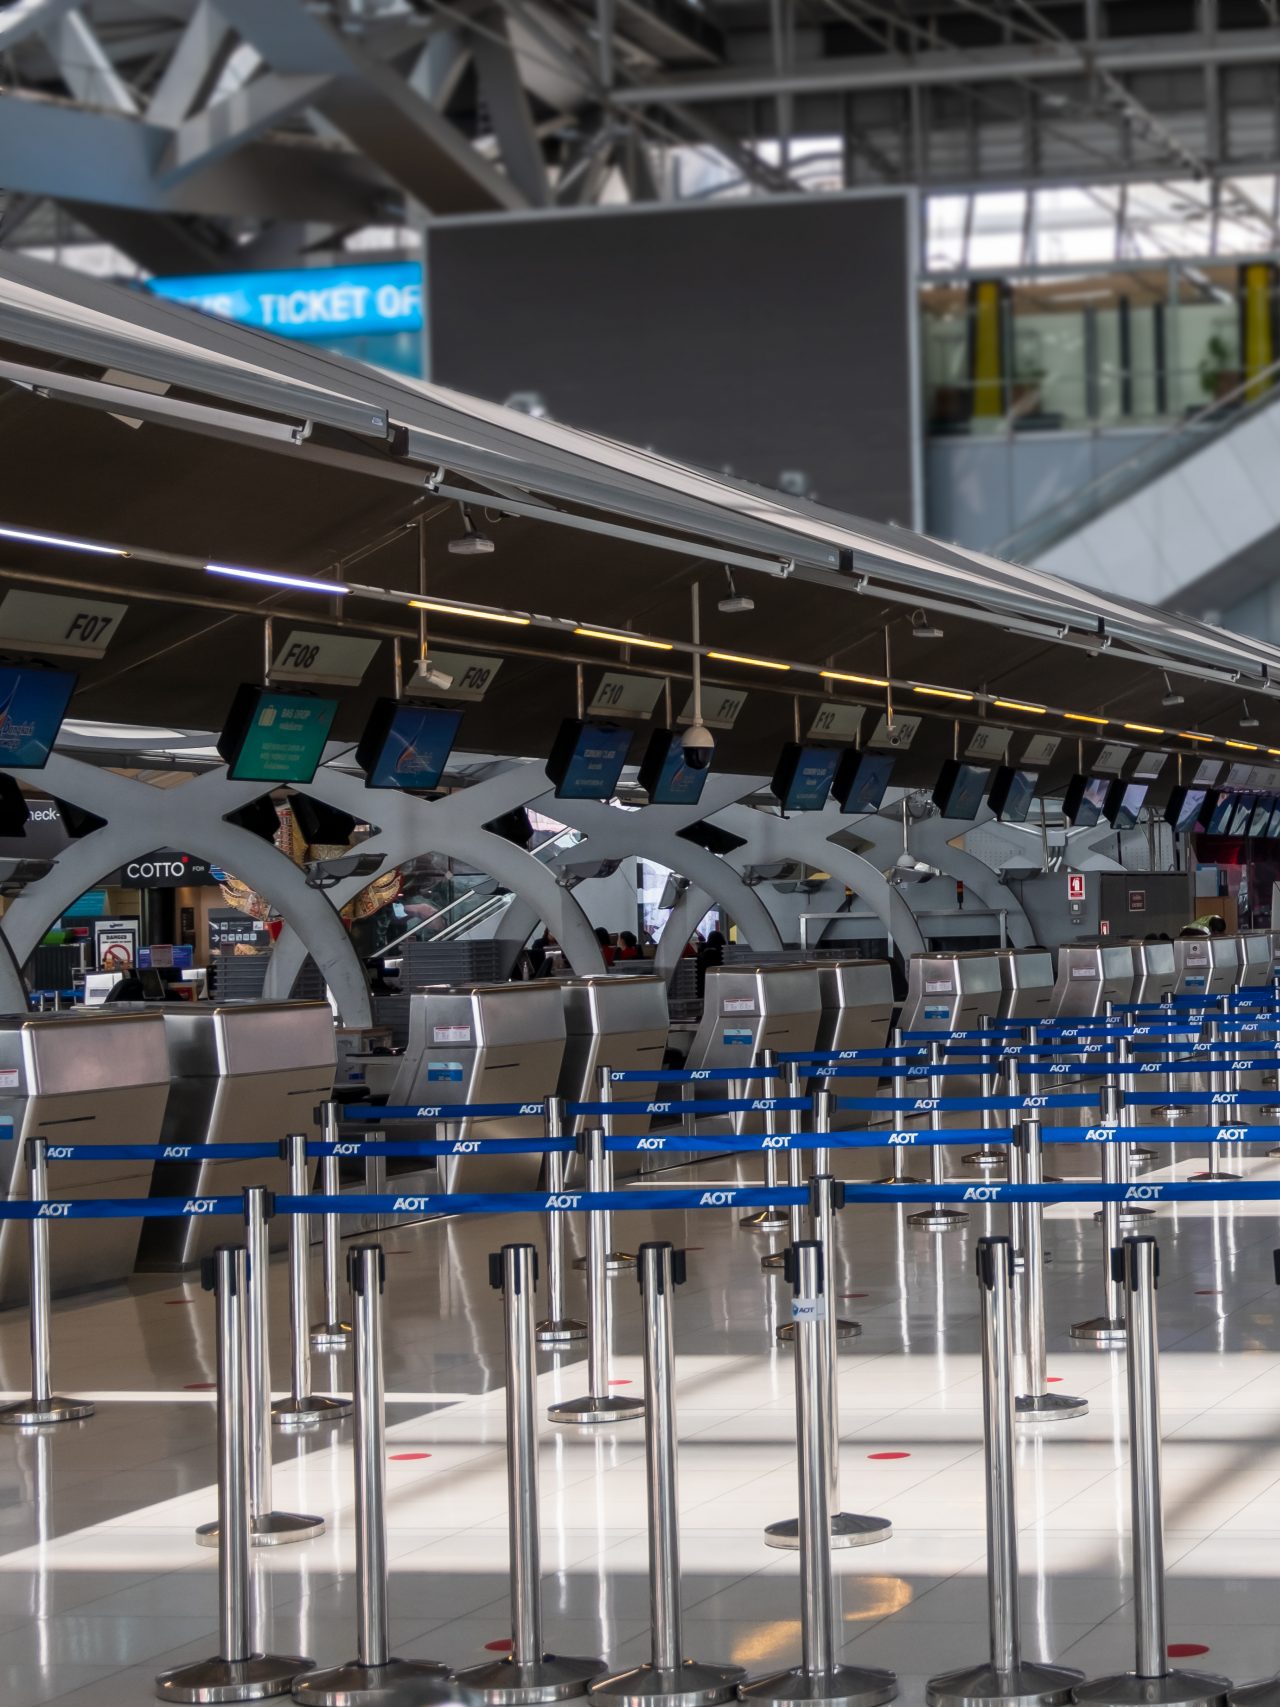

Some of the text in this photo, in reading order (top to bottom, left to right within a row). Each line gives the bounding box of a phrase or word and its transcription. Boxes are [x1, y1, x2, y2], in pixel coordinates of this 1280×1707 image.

[258, 285, 370, 325] TICKET
[65, 613, 113, 642] F07
[282, 643, 320, 669] F08
[459, 667, 492, 690] F09
[599, 683, 624, 705] F10
[718, 699, 740, 717] F11
[815, 711, 836, 730] F12
[127, 862, 185, 878] COTTO
[1083, 1044, 1101, 1052] AOT
[1192, 1043, 1212, 1051] AOT
[1141, 1064, 1160, 1072] AOT
[1232, 1061, 1253, 1069] AOT
[816, 1068, 835, 1076] AOT
[908, 1067, 929, 1075] AOT
[752, 1099, 776, 1109] AOT
[915, 1099, 939, 1109] AOT
[1023, 1097, 1048, 1107] AOT
[1212, 1094, 1238, 1103] AOT
[418, 1108, 440, 1116] AOT
[520, 1105, 543, 1113] AOT
[647, 1103, 671, 1111] AOT
[889, 1133, 918, 1143] AOT
[1086, 1130, 1116, 1141] AOT
[1216, 1128, 1247, 1141] AOT
[453, 1141, 480, 1152] AOT
[637, 1139, 665, 1149] AOT
[762, 1137, 793, 1148] AOT
[47, 1148, 73, 1157] AOT
[164, 1147, 191, 1157] AOT
[333, 1144, 360, 1154] AOT
[964, 1188, 1001, 1200] AOT
[1122, 1186, 1163, 1199] AOT
[394, 1198, 428, 1210] AOT
[546, 1196, 581, 1208] AOT
[700, 1192, 736, 1205] AOT
[38, 1204, 71, 1215] AOT
[183, 1200, 217, 1213] AOT
